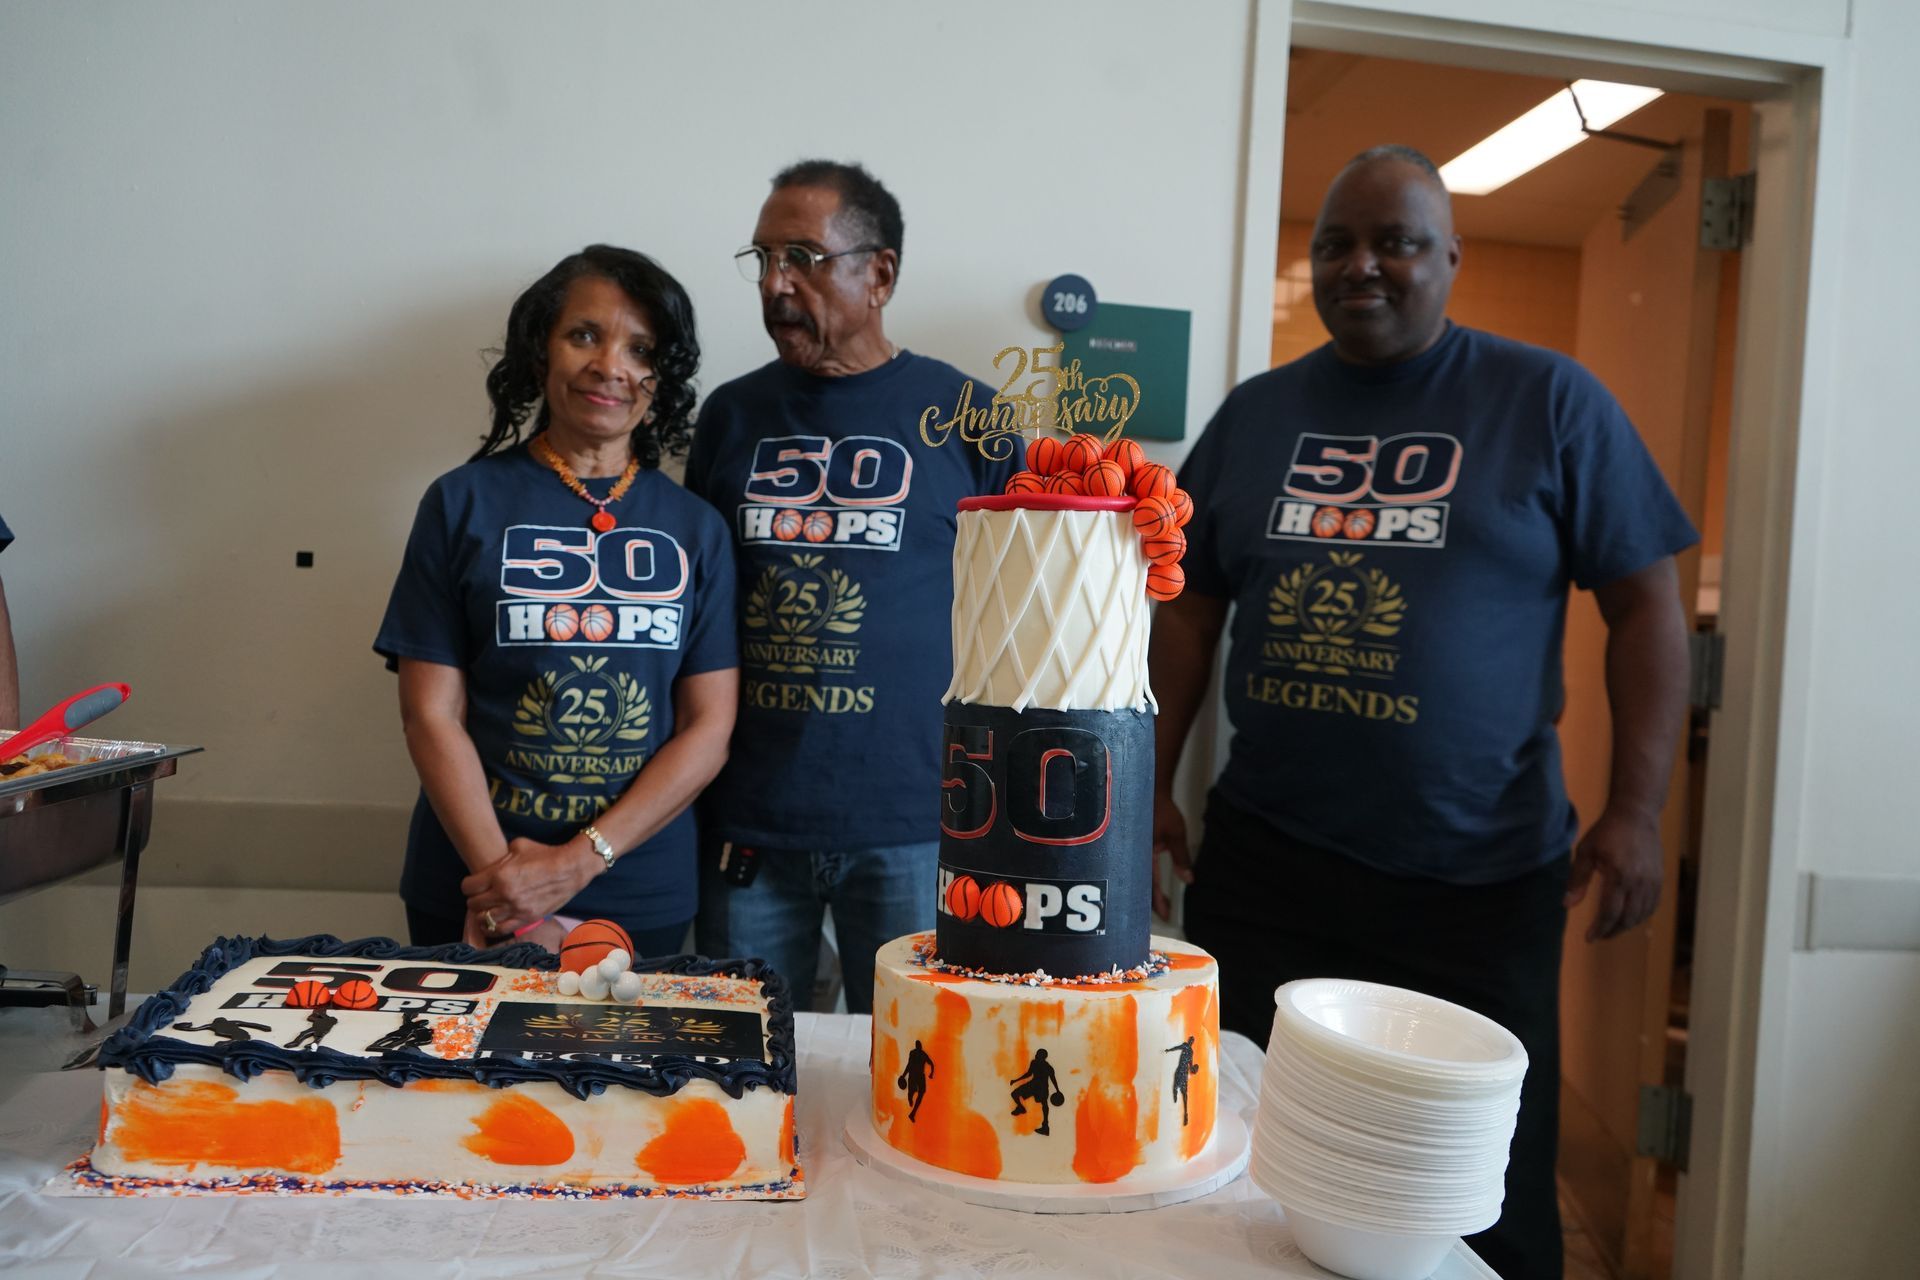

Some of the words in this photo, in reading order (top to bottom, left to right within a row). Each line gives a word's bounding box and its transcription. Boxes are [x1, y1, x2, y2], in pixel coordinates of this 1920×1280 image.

[1053, 292, 1088, 314] 206
[919, 372, 1141, 461] Annivsary
[744, 435, 914, 506] 50
[1283, 432, 1464, 504] 50
[744, 508, 898, 544] HOOPS
[1277, 502, 1442, 542] HOOPS
[500, 524, 689, 600] 50
[508, 603, 680, 643] HOOPS
[1263, 640, 1401, 673] ANNIVERSARY
[745, 680, 875, 714] EGENDS
[1246, 672, 1420, 724] LEGENDS
[504, 749, 646, 775] ANNIVERSARY
[489, 777, 618, 823] LEGEN
[940, 723, 1113, 846] 50
[938, 867, 1102, 932] HOOPS
[237, 980, 471, 1015] HOOPS
[252, 962, 499, 995] 50
